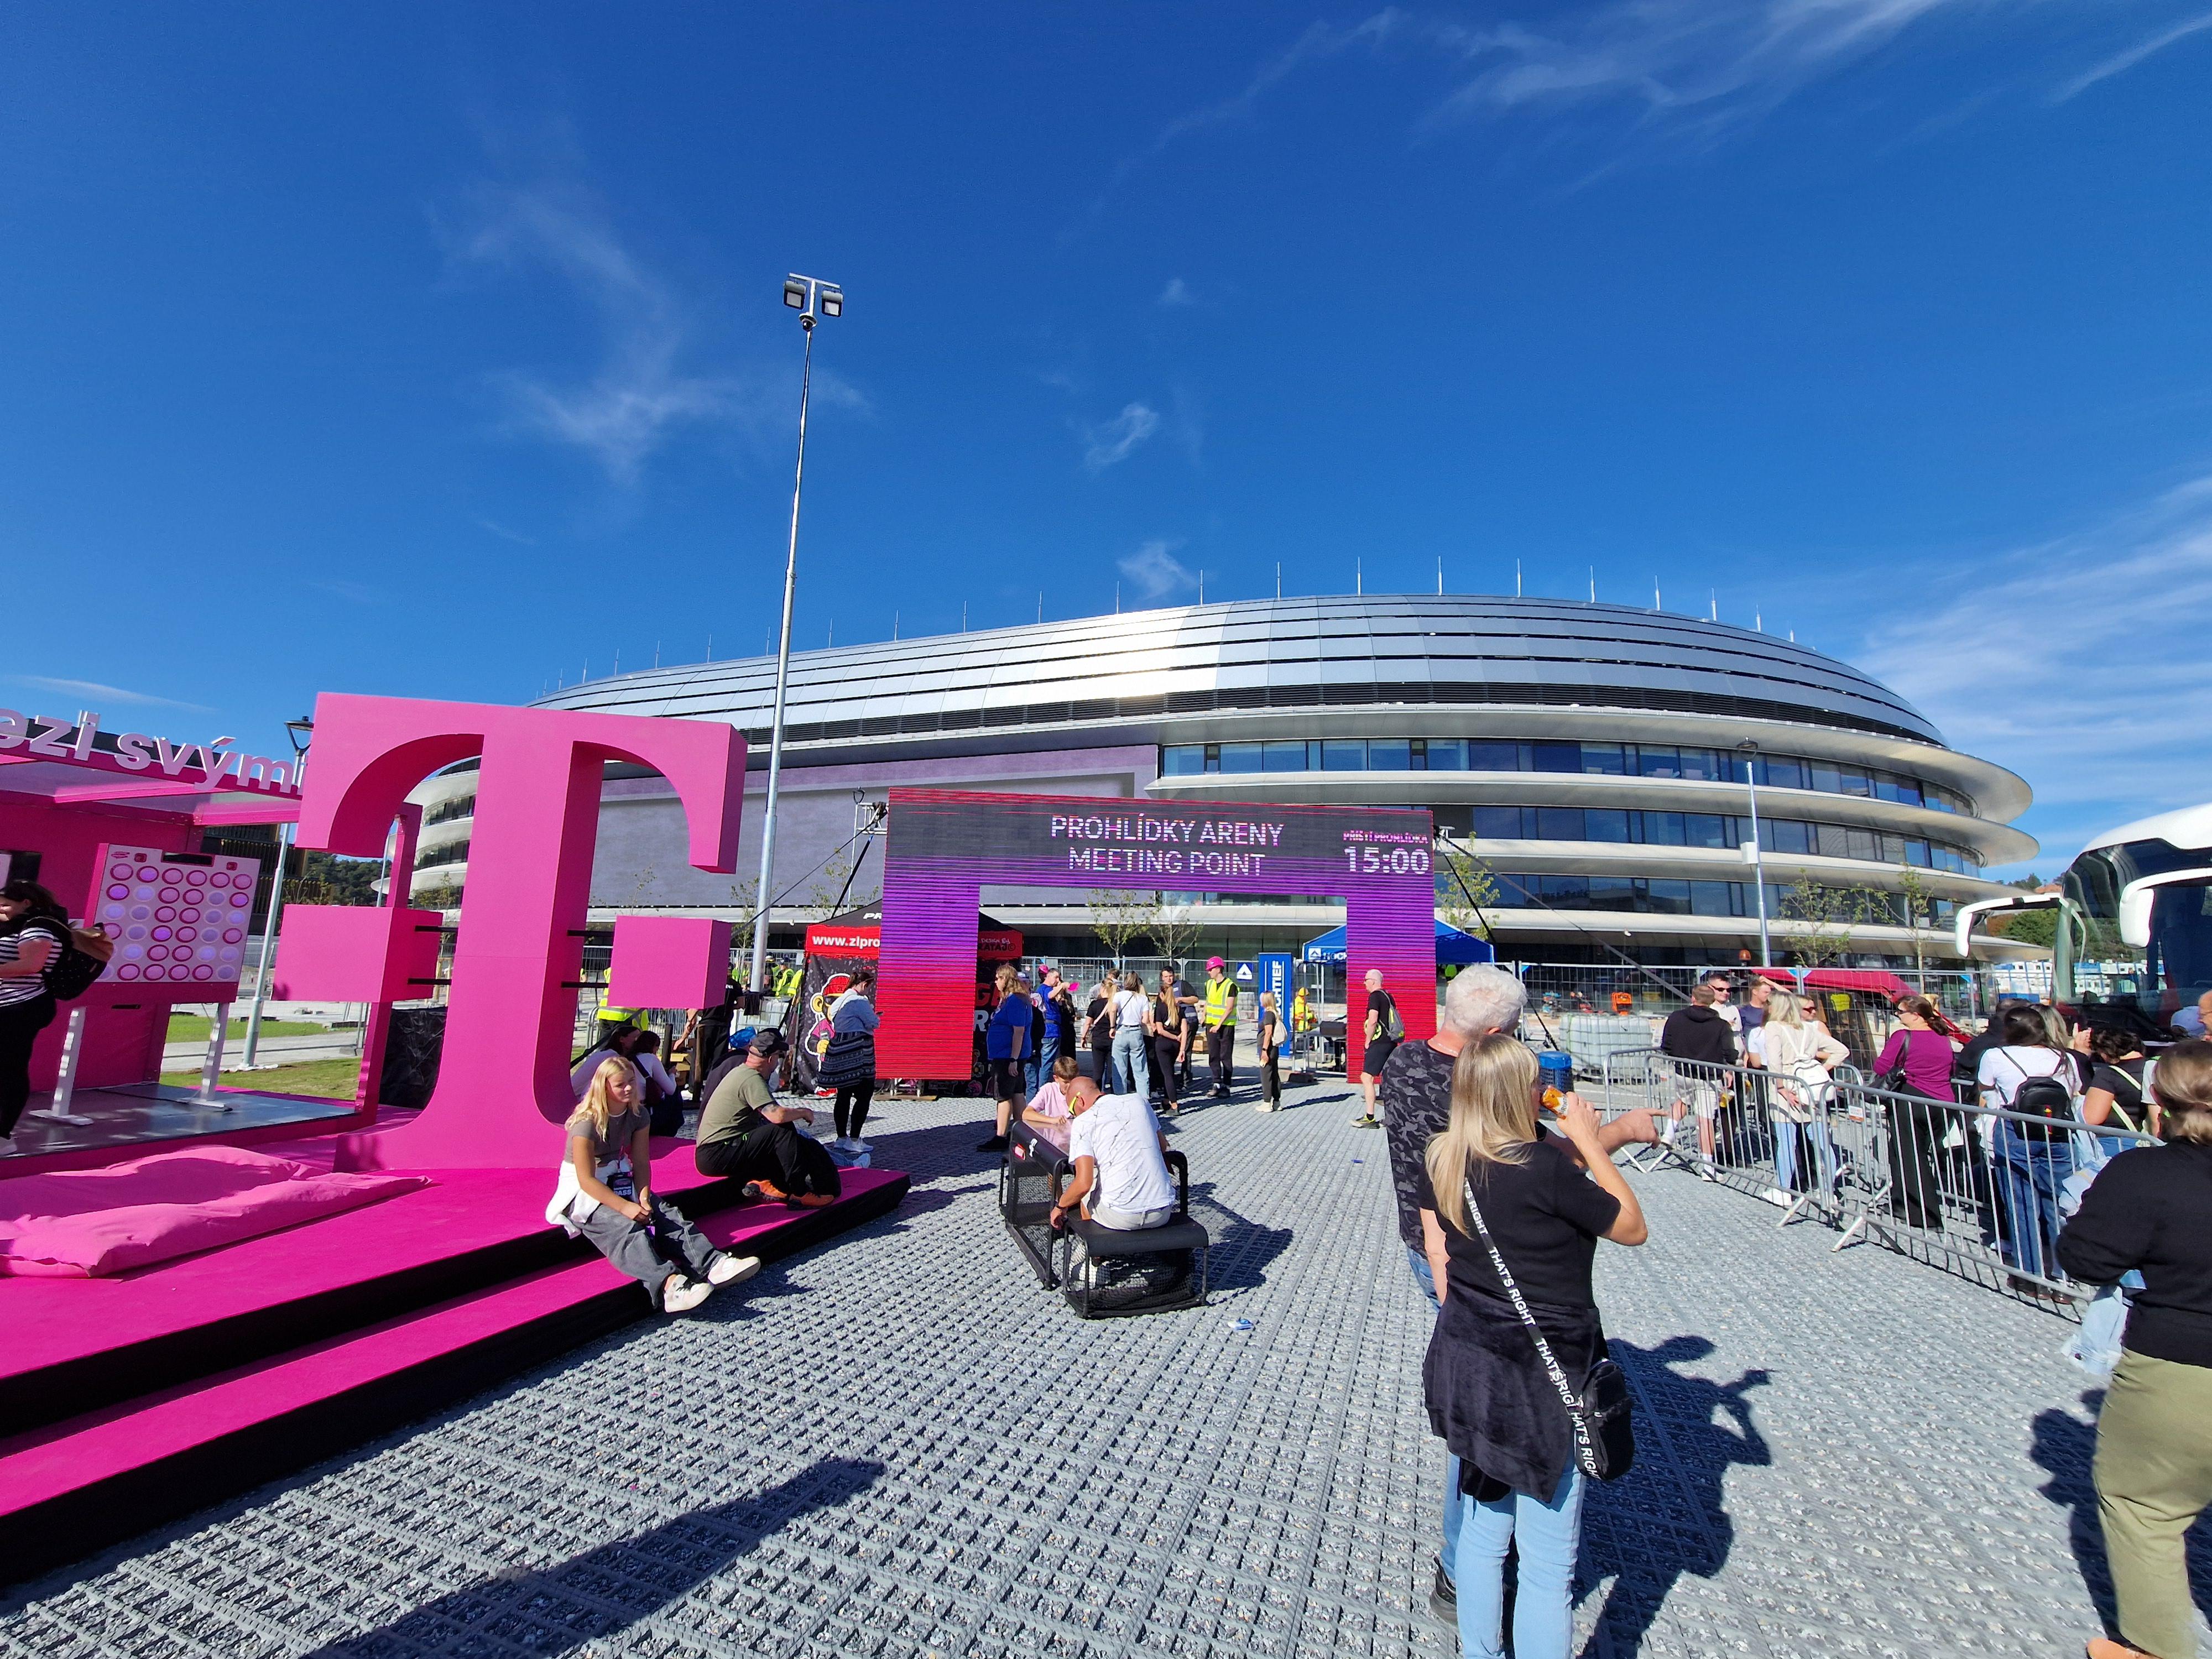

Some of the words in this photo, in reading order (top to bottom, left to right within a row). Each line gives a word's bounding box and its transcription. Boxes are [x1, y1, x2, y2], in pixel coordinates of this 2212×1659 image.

[1051, 812, 1196, 843] PROHLÍDKY
[1199, 821, 1285, 847] ARENY
[1068, 846, 1183, 874] MEETING
[1190, 850, 1266, 876] POINT
[1344, 846, 1430, 875] 15:00
[1468, 1199, 1489, 1235] RIGHT
[1489, 1246, 1515, 1288] THAT'S
[1509, 1288, 1536, 1326] RIGHT
